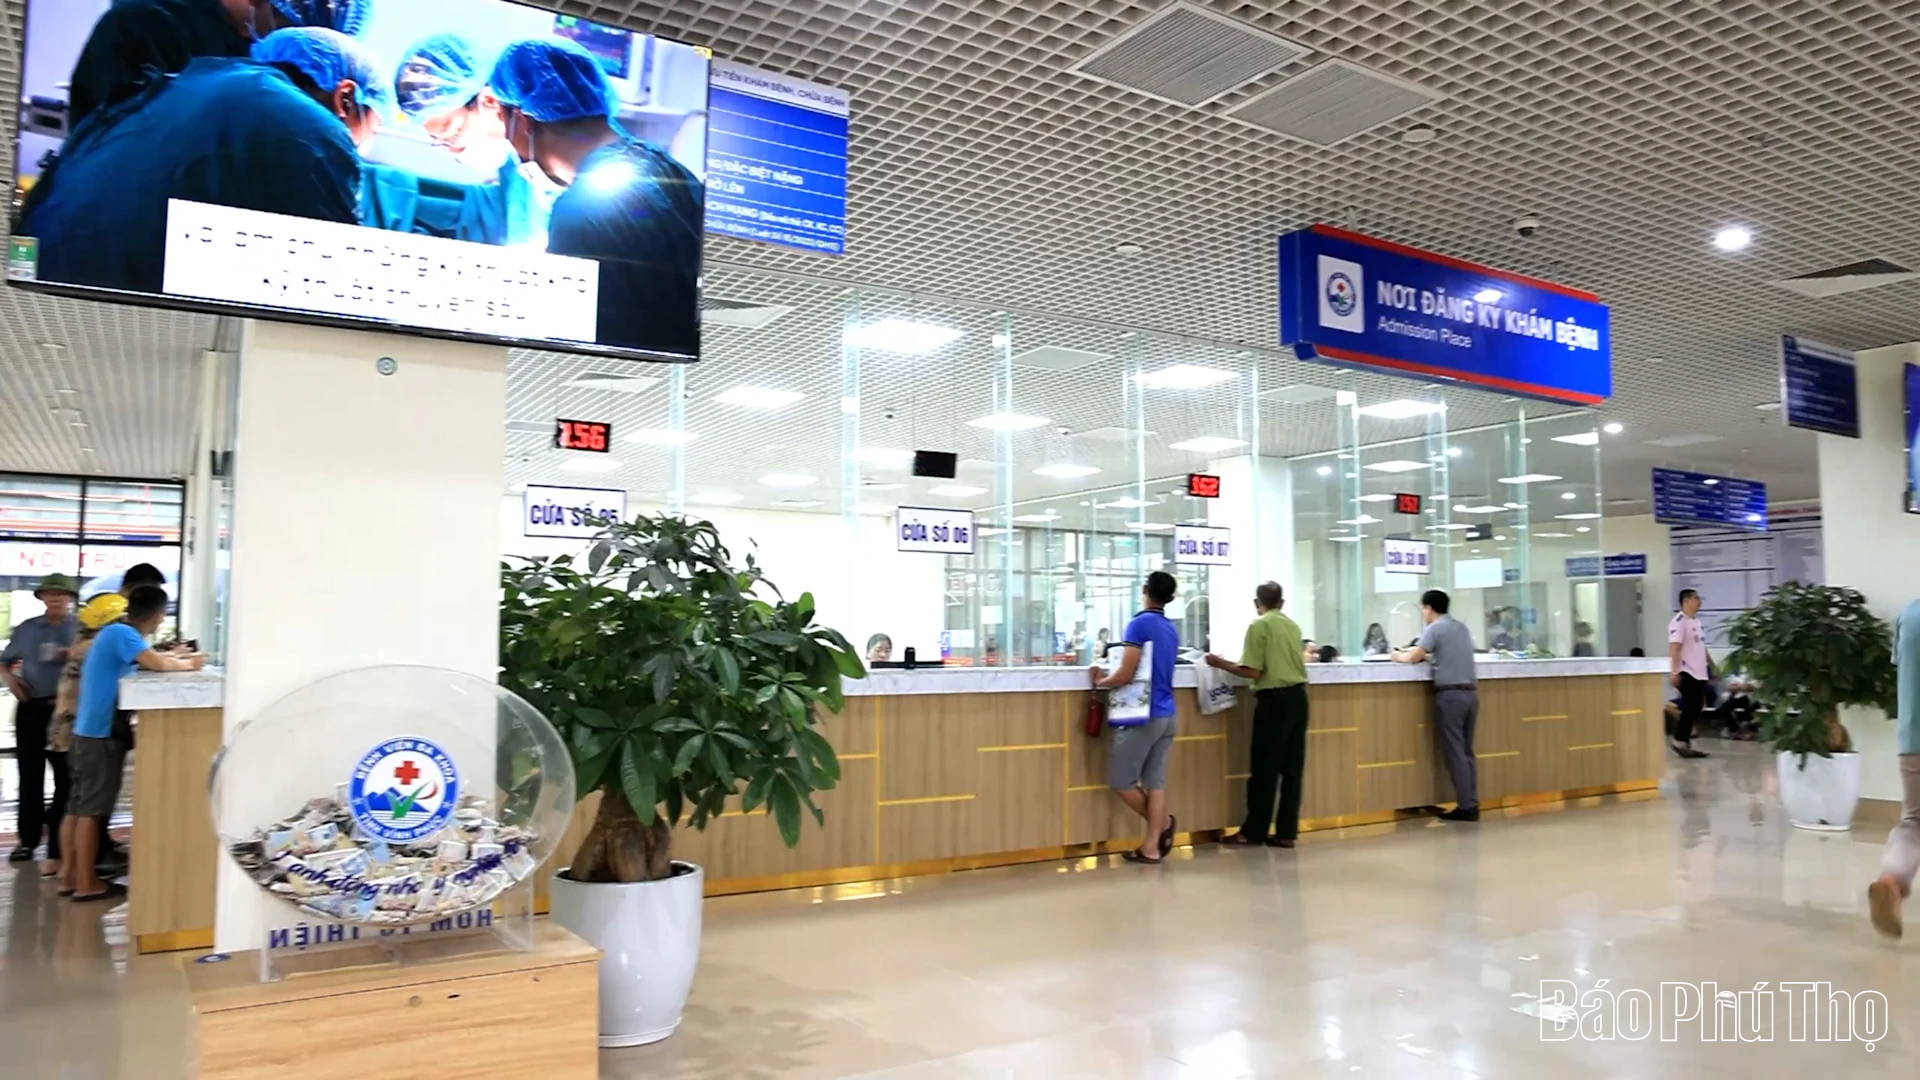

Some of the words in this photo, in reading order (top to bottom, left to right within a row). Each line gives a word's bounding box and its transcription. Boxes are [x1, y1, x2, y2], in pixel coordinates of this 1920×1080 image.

[1378, 280, 1417, 311] NƠI
[1421, 286, 1474, 323] ĐĂNG
[1505, 308, 1553, 341] KHÁM
[1556, 317, 1599, 351] BỆNH
[1378, 316, 1438, 341] Admission
[1441, 328, 1472, 348] Place
[559, 421, 606, 450] 156
[530, 498, 564, 525] CỬA
[901, 518, 928, 542] CỬA
[932, 520, 950, 542] SỐ
[433, 754, 456, 784] KHOA
